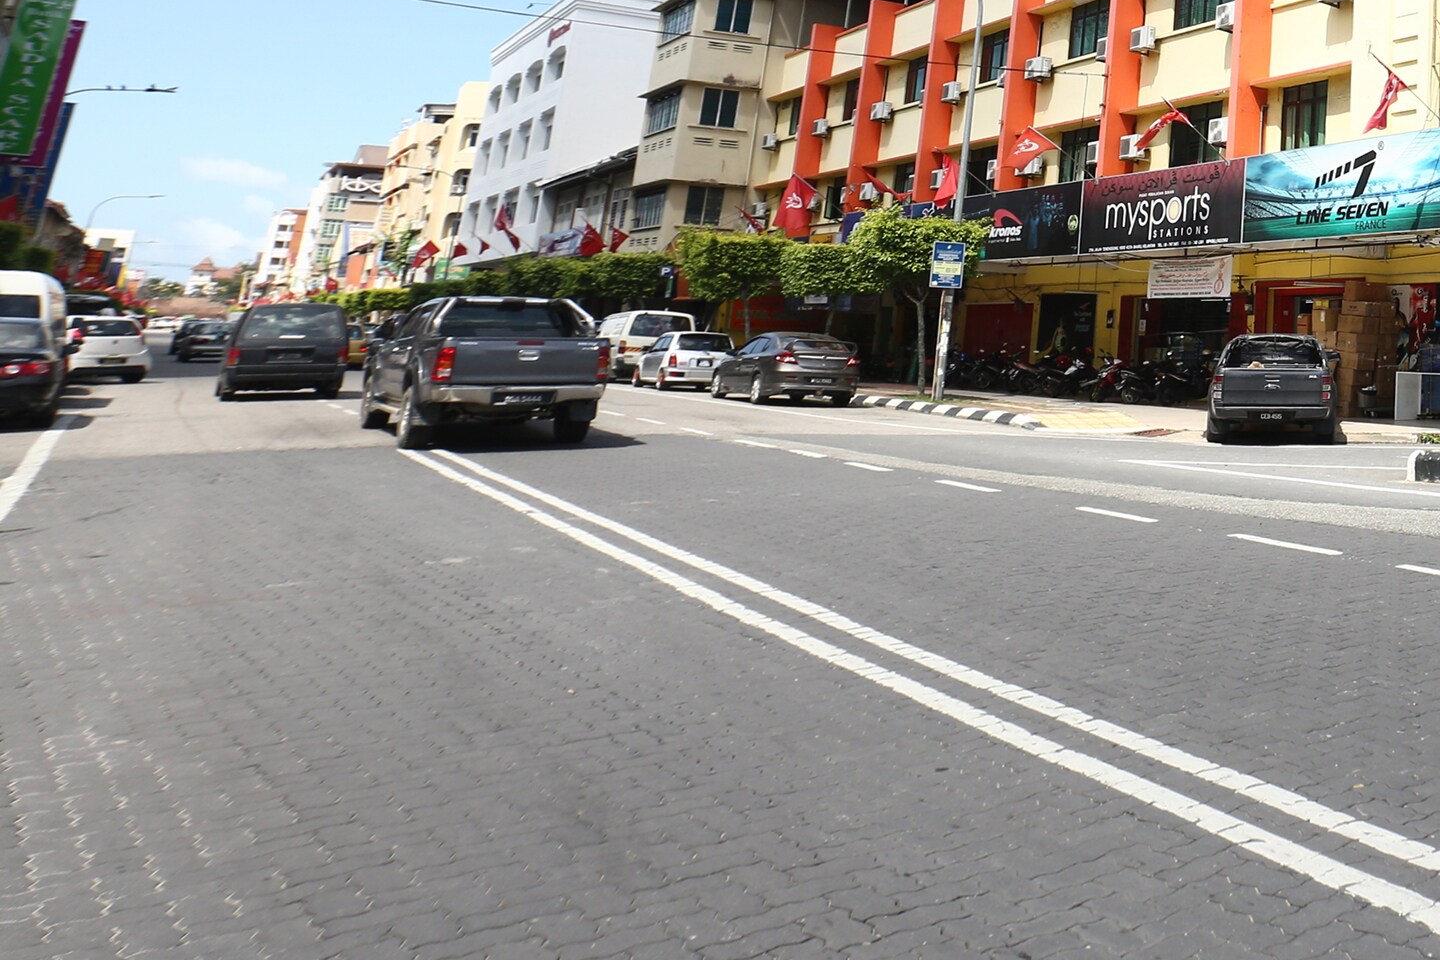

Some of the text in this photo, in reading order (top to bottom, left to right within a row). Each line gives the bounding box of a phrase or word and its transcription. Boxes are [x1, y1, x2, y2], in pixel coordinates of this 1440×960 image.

[1105, 185, 1210, 240] mysports
[1296, 201, 1389, 225] LINE SEVEN
[1355, 219, 1387, 230] FRANCE
[989, 225, 1023, 238] kronos
[1153, 225, 1209, 239] STATIONS
[661, 267, 671, 277] P
